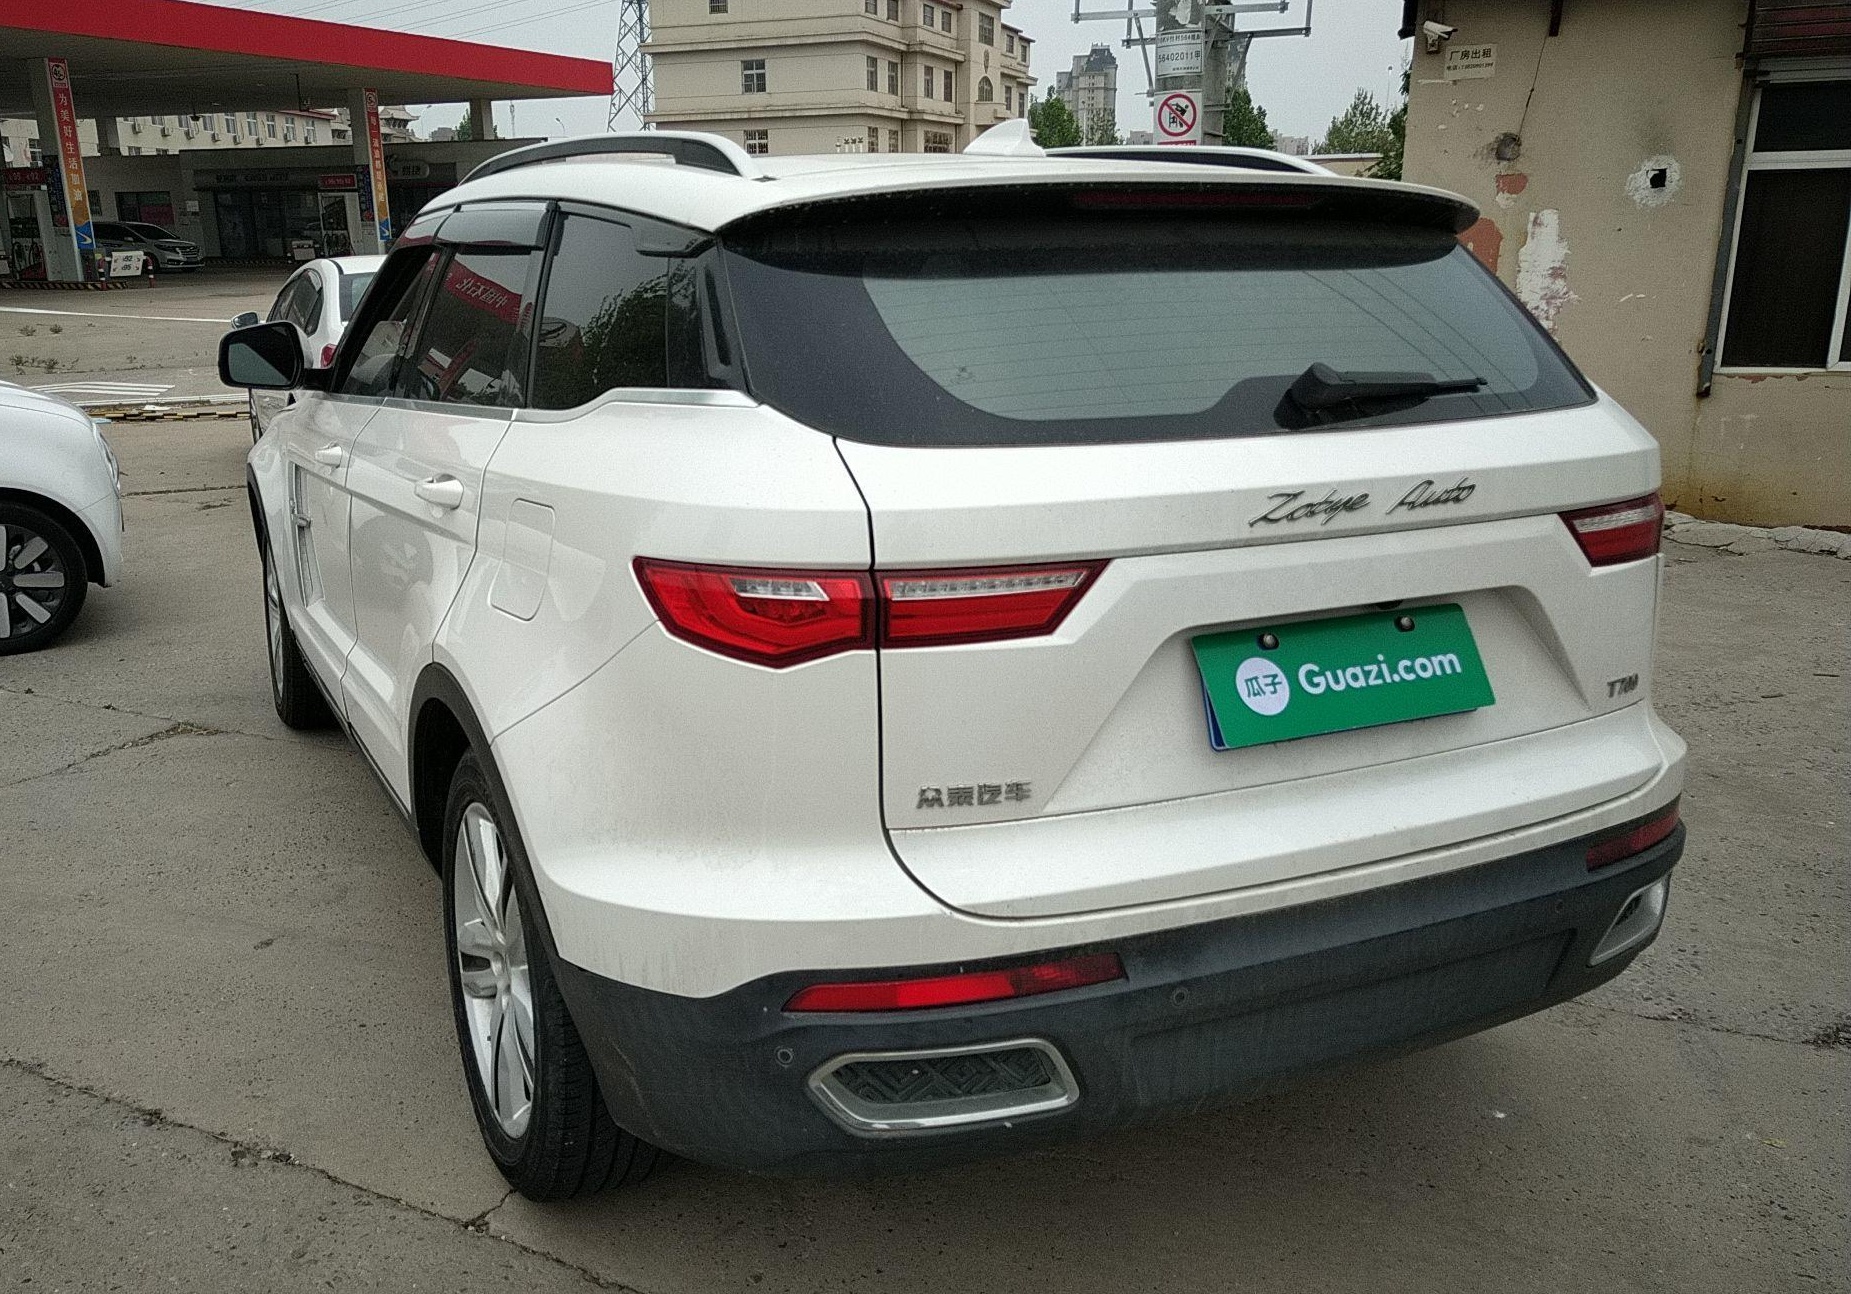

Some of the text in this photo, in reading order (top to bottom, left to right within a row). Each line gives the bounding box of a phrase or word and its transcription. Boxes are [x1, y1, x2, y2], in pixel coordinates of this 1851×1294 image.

[1449, 48, 1492, 61] 厂房出租
[58, 93, 83, 202] 为美好生活加油
[1249, 477, 1477, 527] Zotye Auto
[1244, 673, 1283, 698] 瓜子
[1298, 653, 1462, 695] Guazi.com
[916, 781, 1032, 809] 众泰汽车
